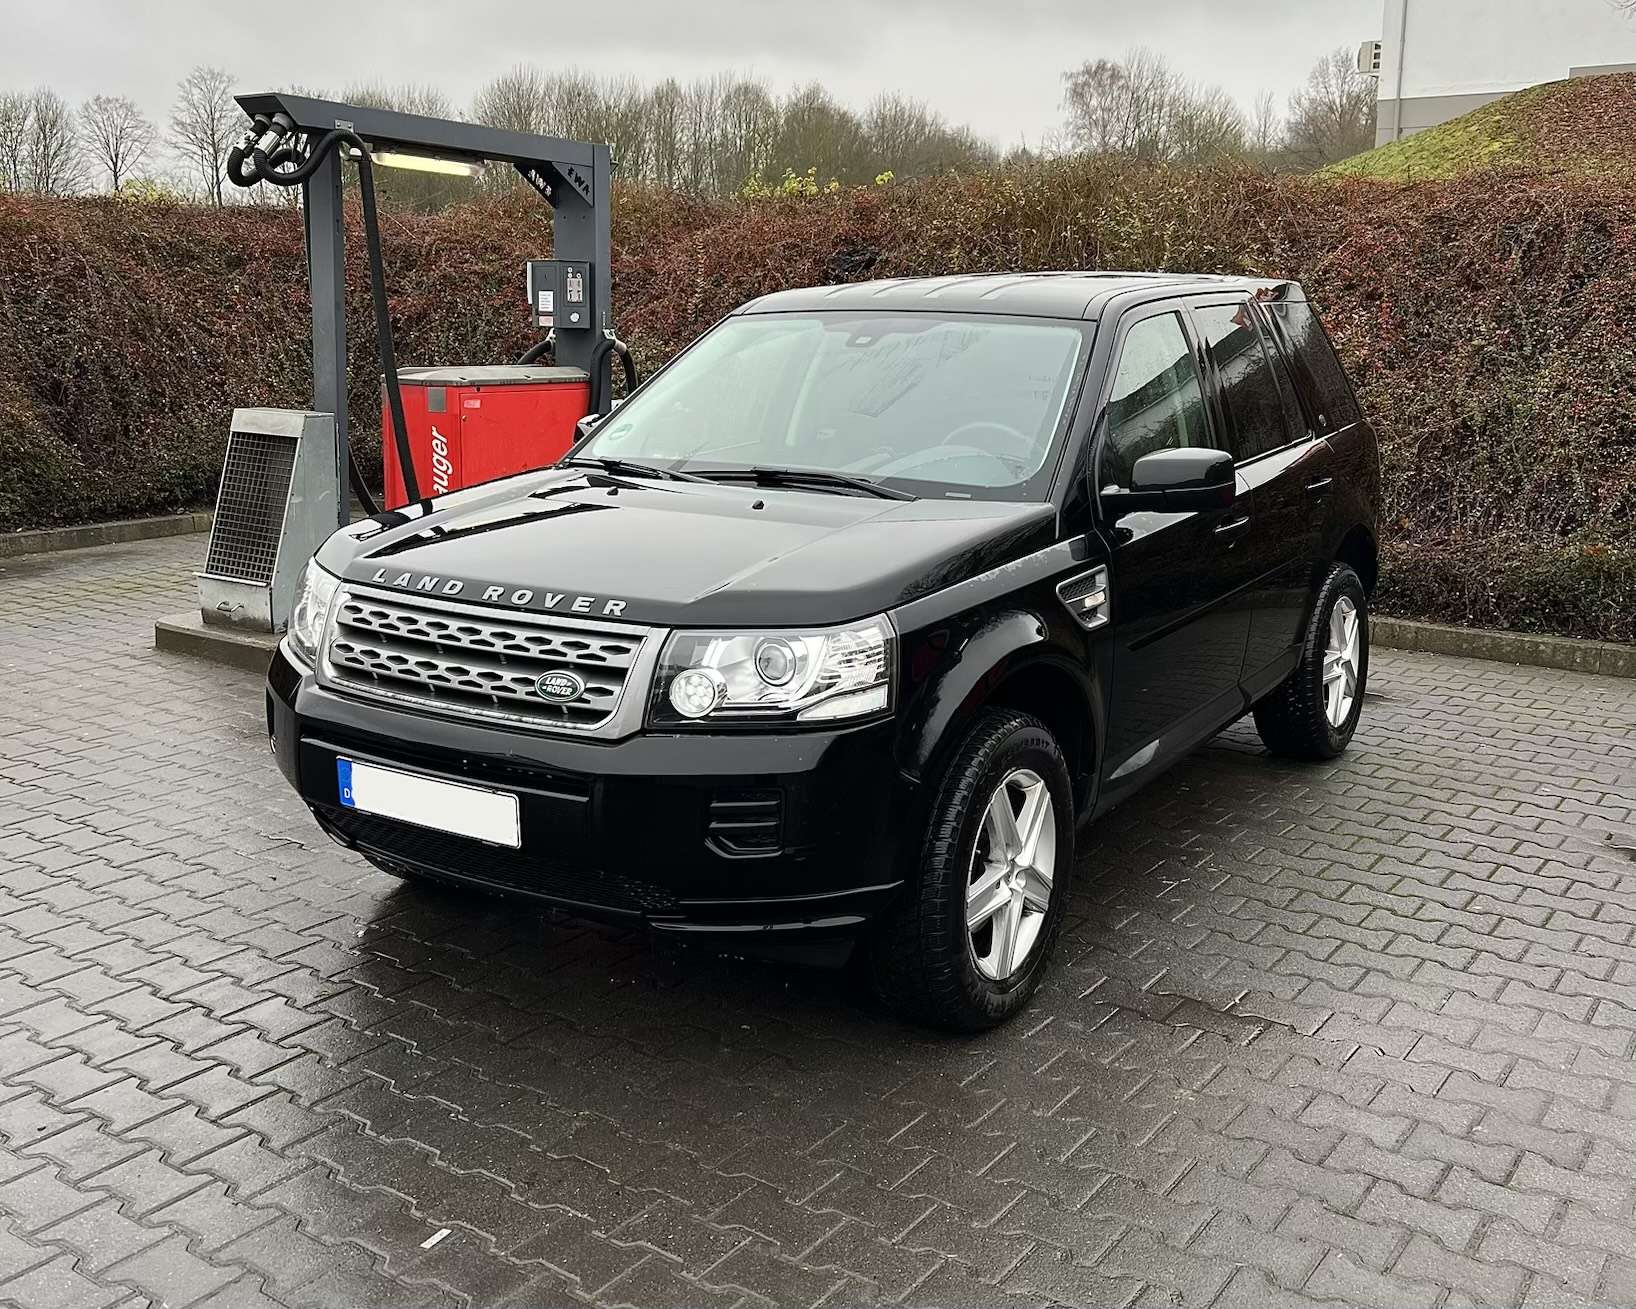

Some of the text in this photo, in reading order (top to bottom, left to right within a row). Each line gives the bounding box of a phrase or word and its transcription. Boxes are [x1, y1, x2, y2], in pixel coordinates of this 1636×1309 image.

[372, 568, 627, 616] LAND ROVER
[545, 676, 568, 687] LAND
[546, 684, 573, 696] ROVER
[343, 787, 351, 799] D
